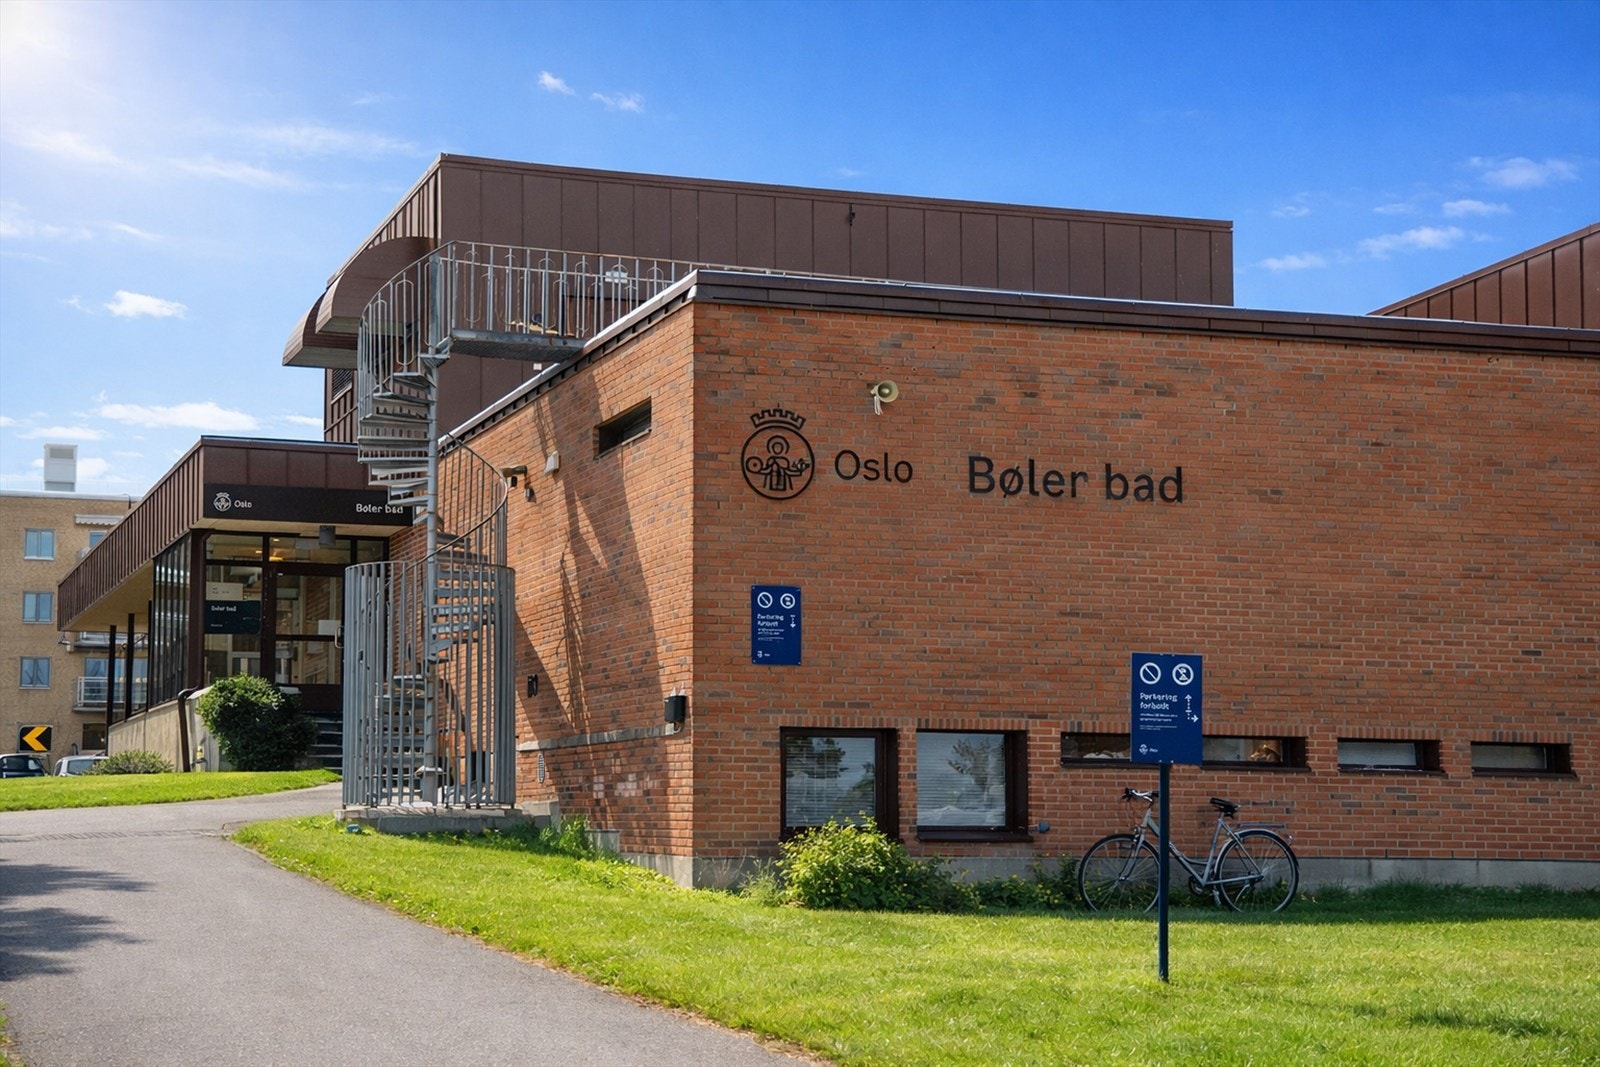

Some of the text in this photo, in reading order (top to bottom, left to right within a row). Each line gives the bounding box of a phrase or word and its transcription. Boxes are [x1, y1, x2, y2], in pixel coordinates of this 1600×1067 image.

[834, 449, 913, 483] Oslo
[968, 456, 1184, 504] Bøler bad
